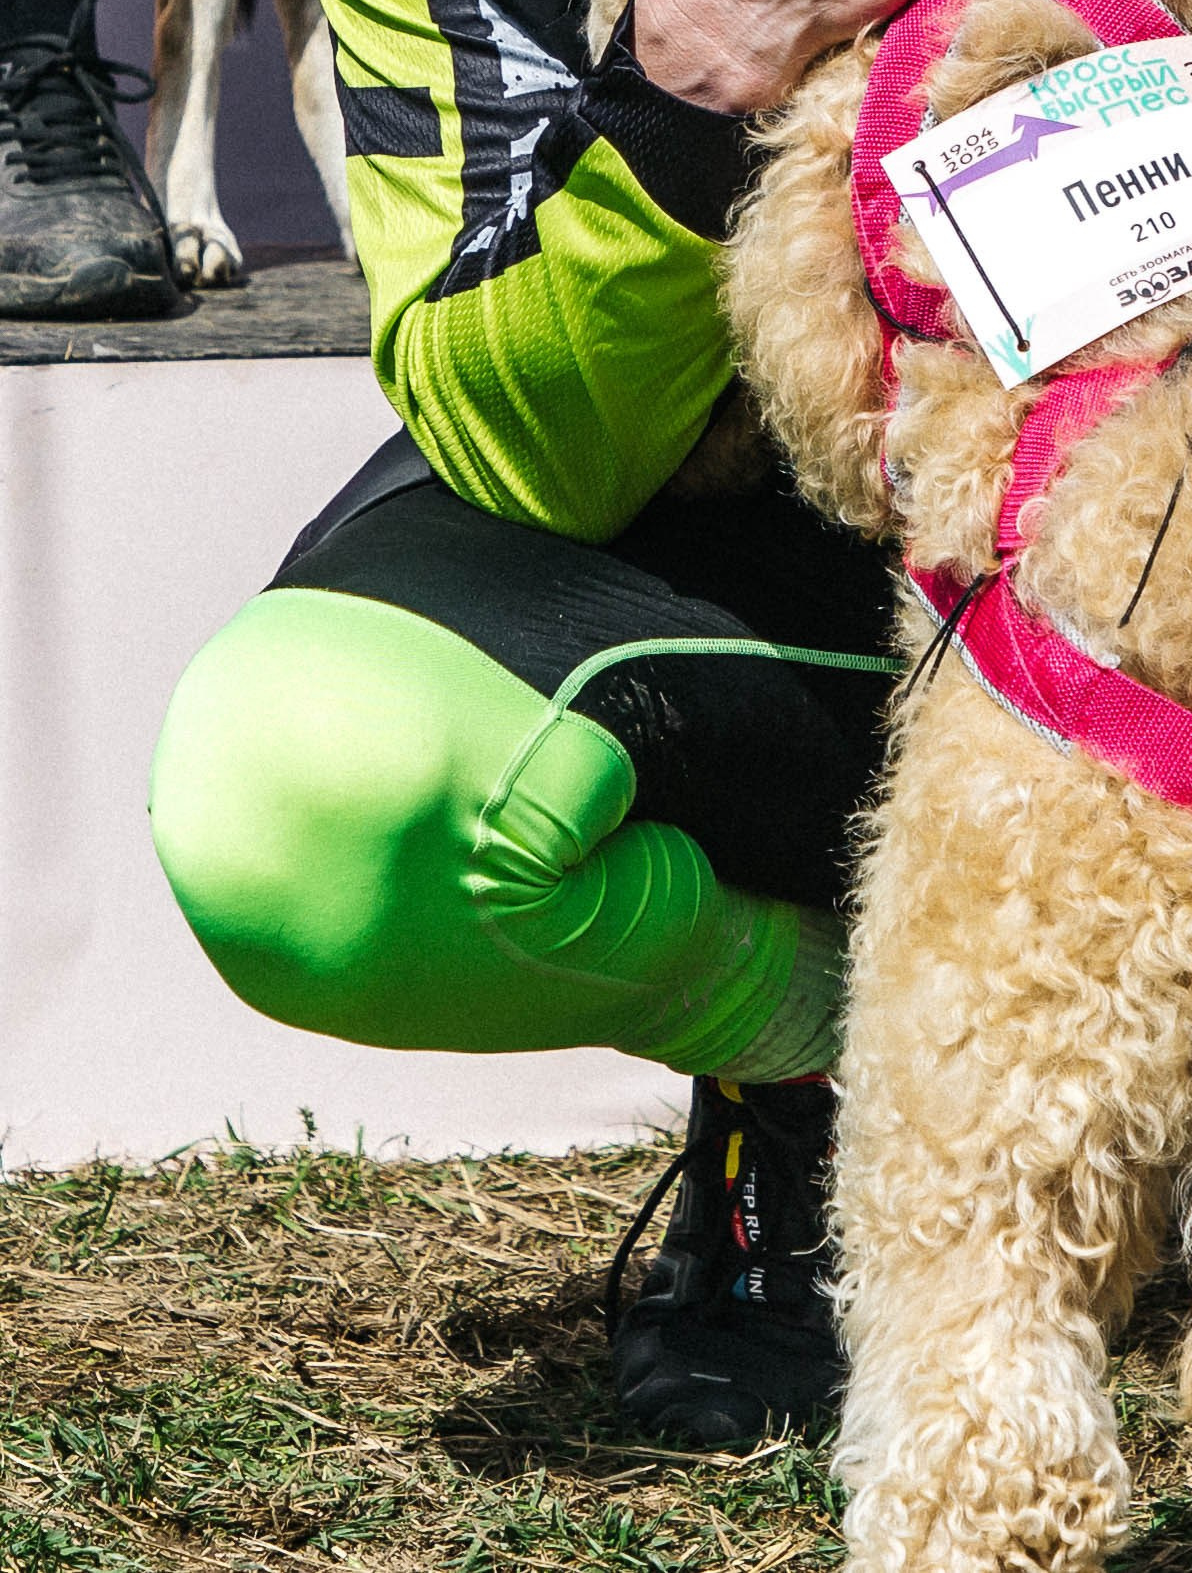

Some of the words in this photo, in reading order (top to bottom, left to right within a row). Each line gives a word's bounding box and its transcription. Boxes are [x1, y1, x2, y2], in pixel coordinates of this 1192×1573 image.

[1027, 48, 1140, 101] КРОСС
[1040, 58, 1180, 122] БЫСТРЫЙ
[939, 127, 993, 164] 19.04
[945, 137, 1000, 174] 2025
[1062, 152, 1192, 223] Пенни
[1130, 211, 1177, 243] 210
[1109, 268, 1138, 287] СЕТЬ
